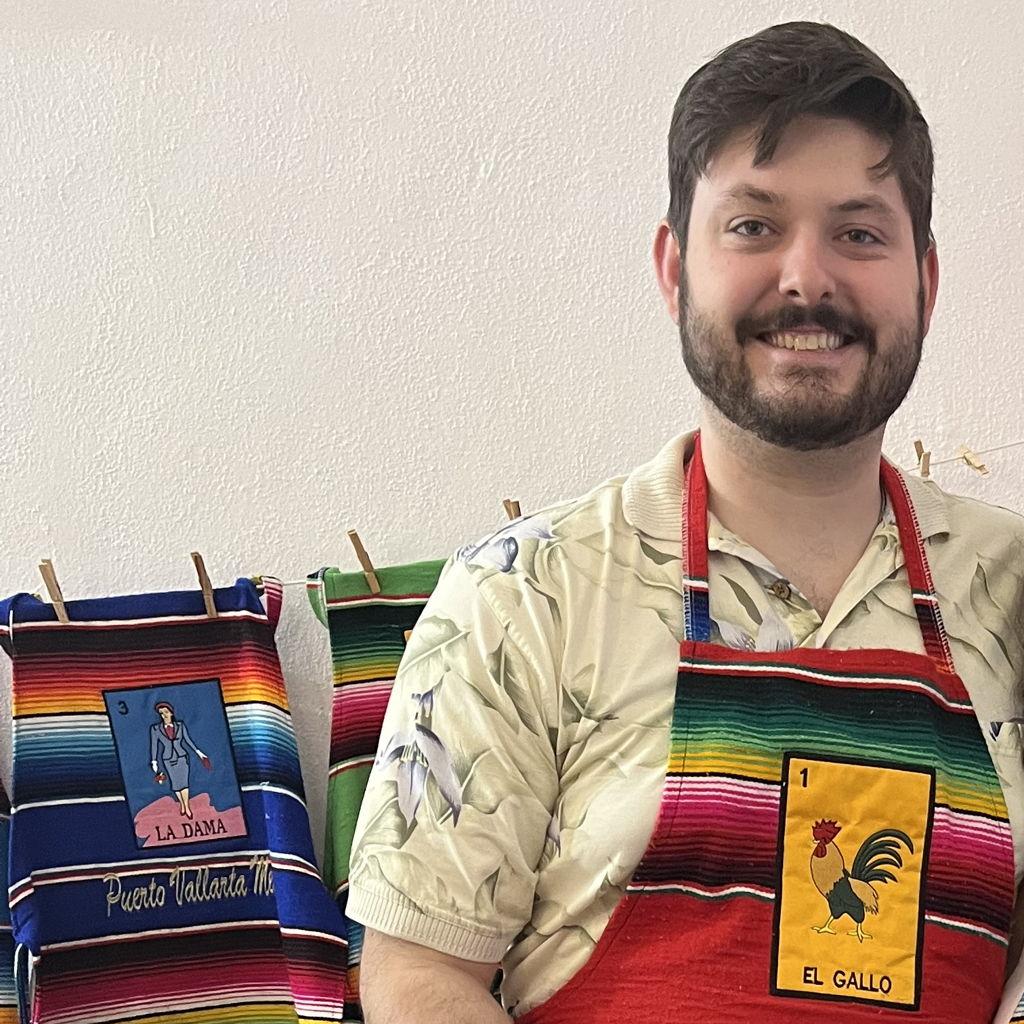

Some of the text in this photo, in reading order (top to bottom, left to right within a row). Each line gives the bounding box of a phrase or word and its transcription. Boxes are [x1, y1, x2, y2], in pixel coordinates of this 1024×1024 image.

[799, 767, 809, 788] 1
[155, 818, 227, 841] LA DAMA
[103, 872, 165, 917] Puerto
[803, 966, 892, 994] EL GALLO
